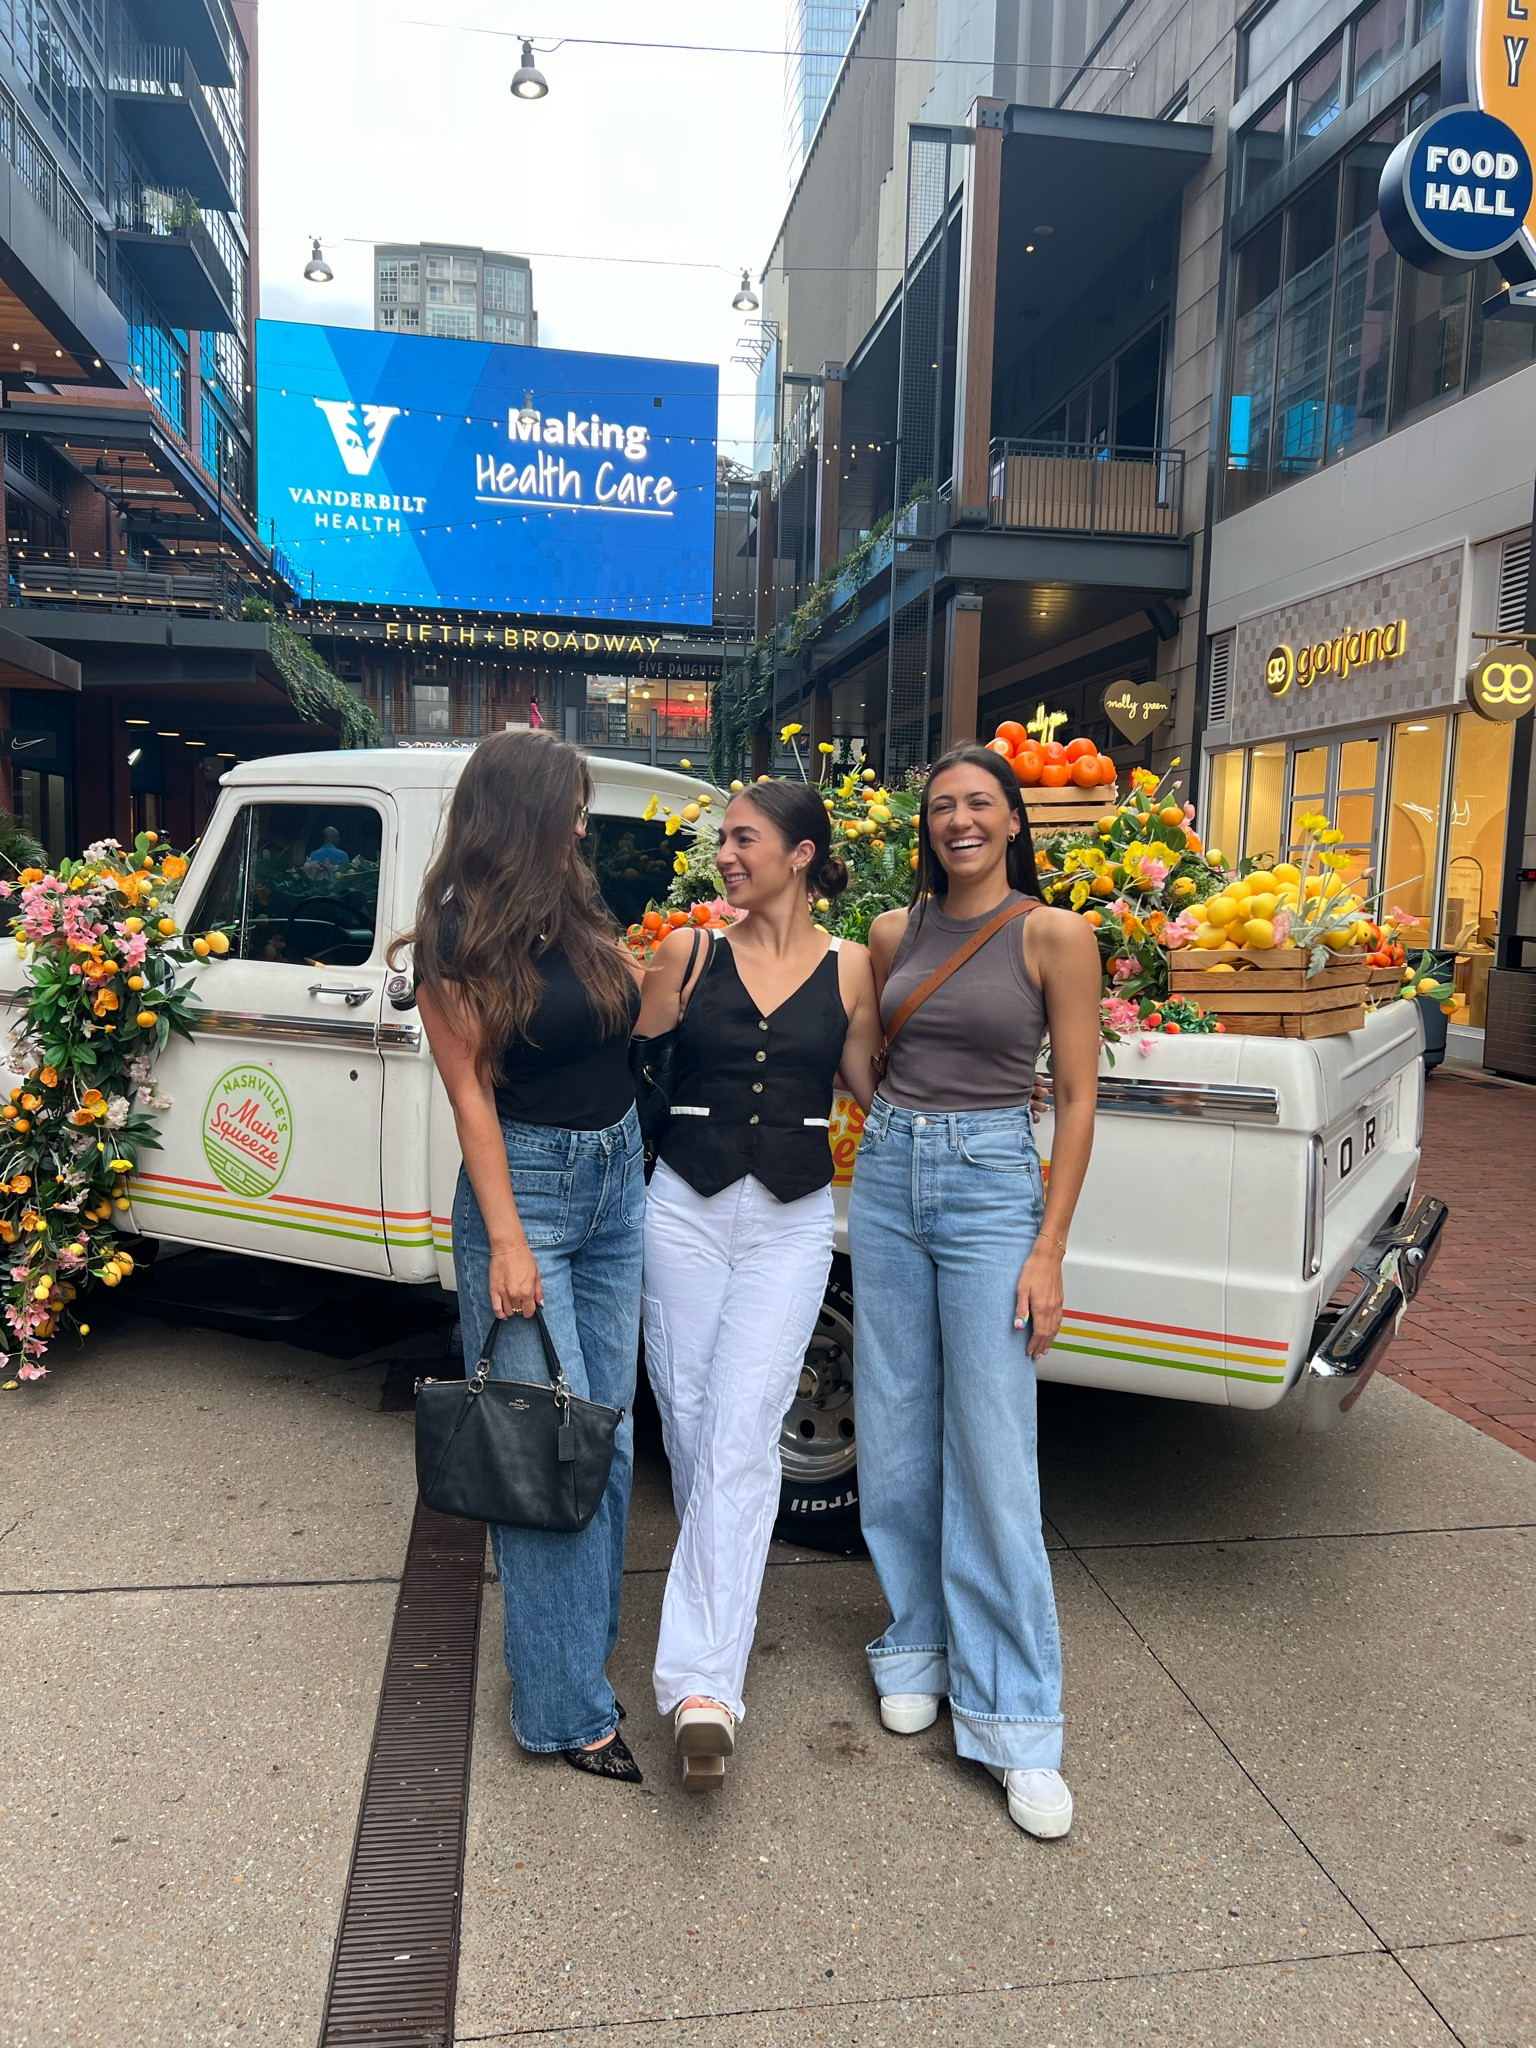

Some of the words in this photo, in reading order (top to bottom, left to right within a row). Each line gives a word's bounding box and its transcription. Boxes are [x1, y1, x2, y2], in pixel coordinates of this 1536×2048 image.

[1426, 145, 1519, 180] FOOD
[1425, 182, 1515, 217] HALL
[507, 406, 648, 460] Making
[475, 449, 581, 499] Health
[595, 461, 677, 505] Care
[288, 486, 427, 513] VANDERBILT
[315, 512, 400, 533] HEALTH
[386, 622, 475, 644] FIFTH
[504, 628, 661, 653] BROADWAY
[1296, 619, 1406, 688] gorjana
[638, 661, 664, 673] FIVE
[668, 662, 721, 676] DAUGHTE
[1106, 693, 1139, 719] molly
[1142, 701, 1168, 720] green
[223, 1074, 288, 1132] NASHVILLE'S
[210, 1102, 279, 1164] Squeeze
[230, 1098, 279, 1145] Main
[790, 1490, 858, 1513] Trail
